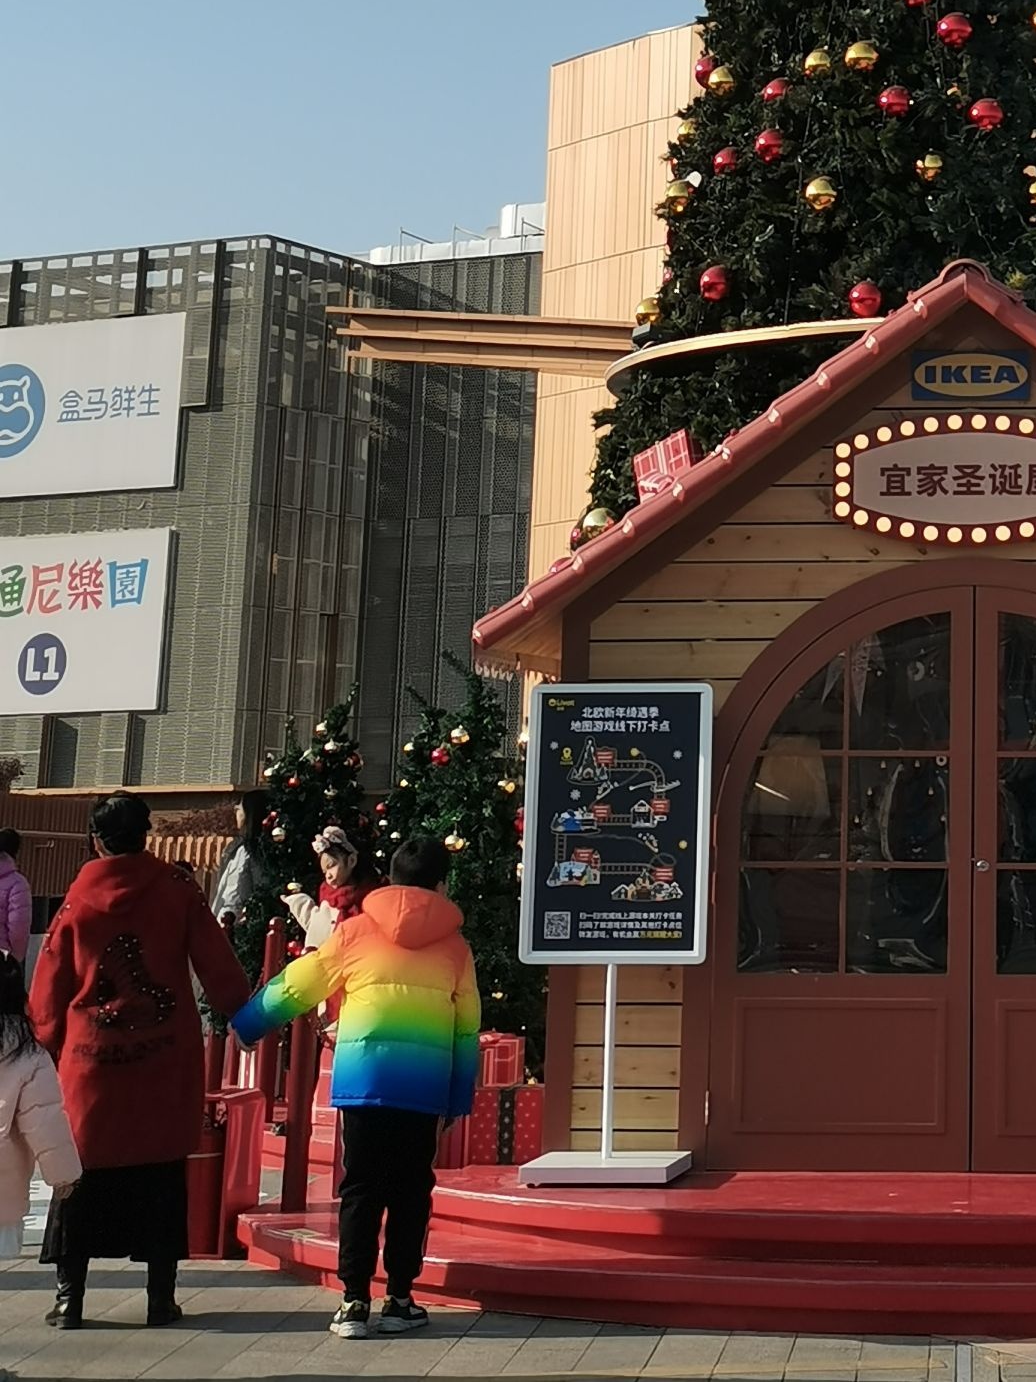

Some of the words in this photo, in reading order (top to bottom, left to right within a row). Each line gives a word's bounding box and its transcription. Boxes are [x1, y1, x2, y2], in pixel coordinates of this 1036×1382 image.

[924, 365, 1020, 384] IKEA
[57, 383, 161, 423] 盒马鲜生
[25, 646, 60, 682] L1
